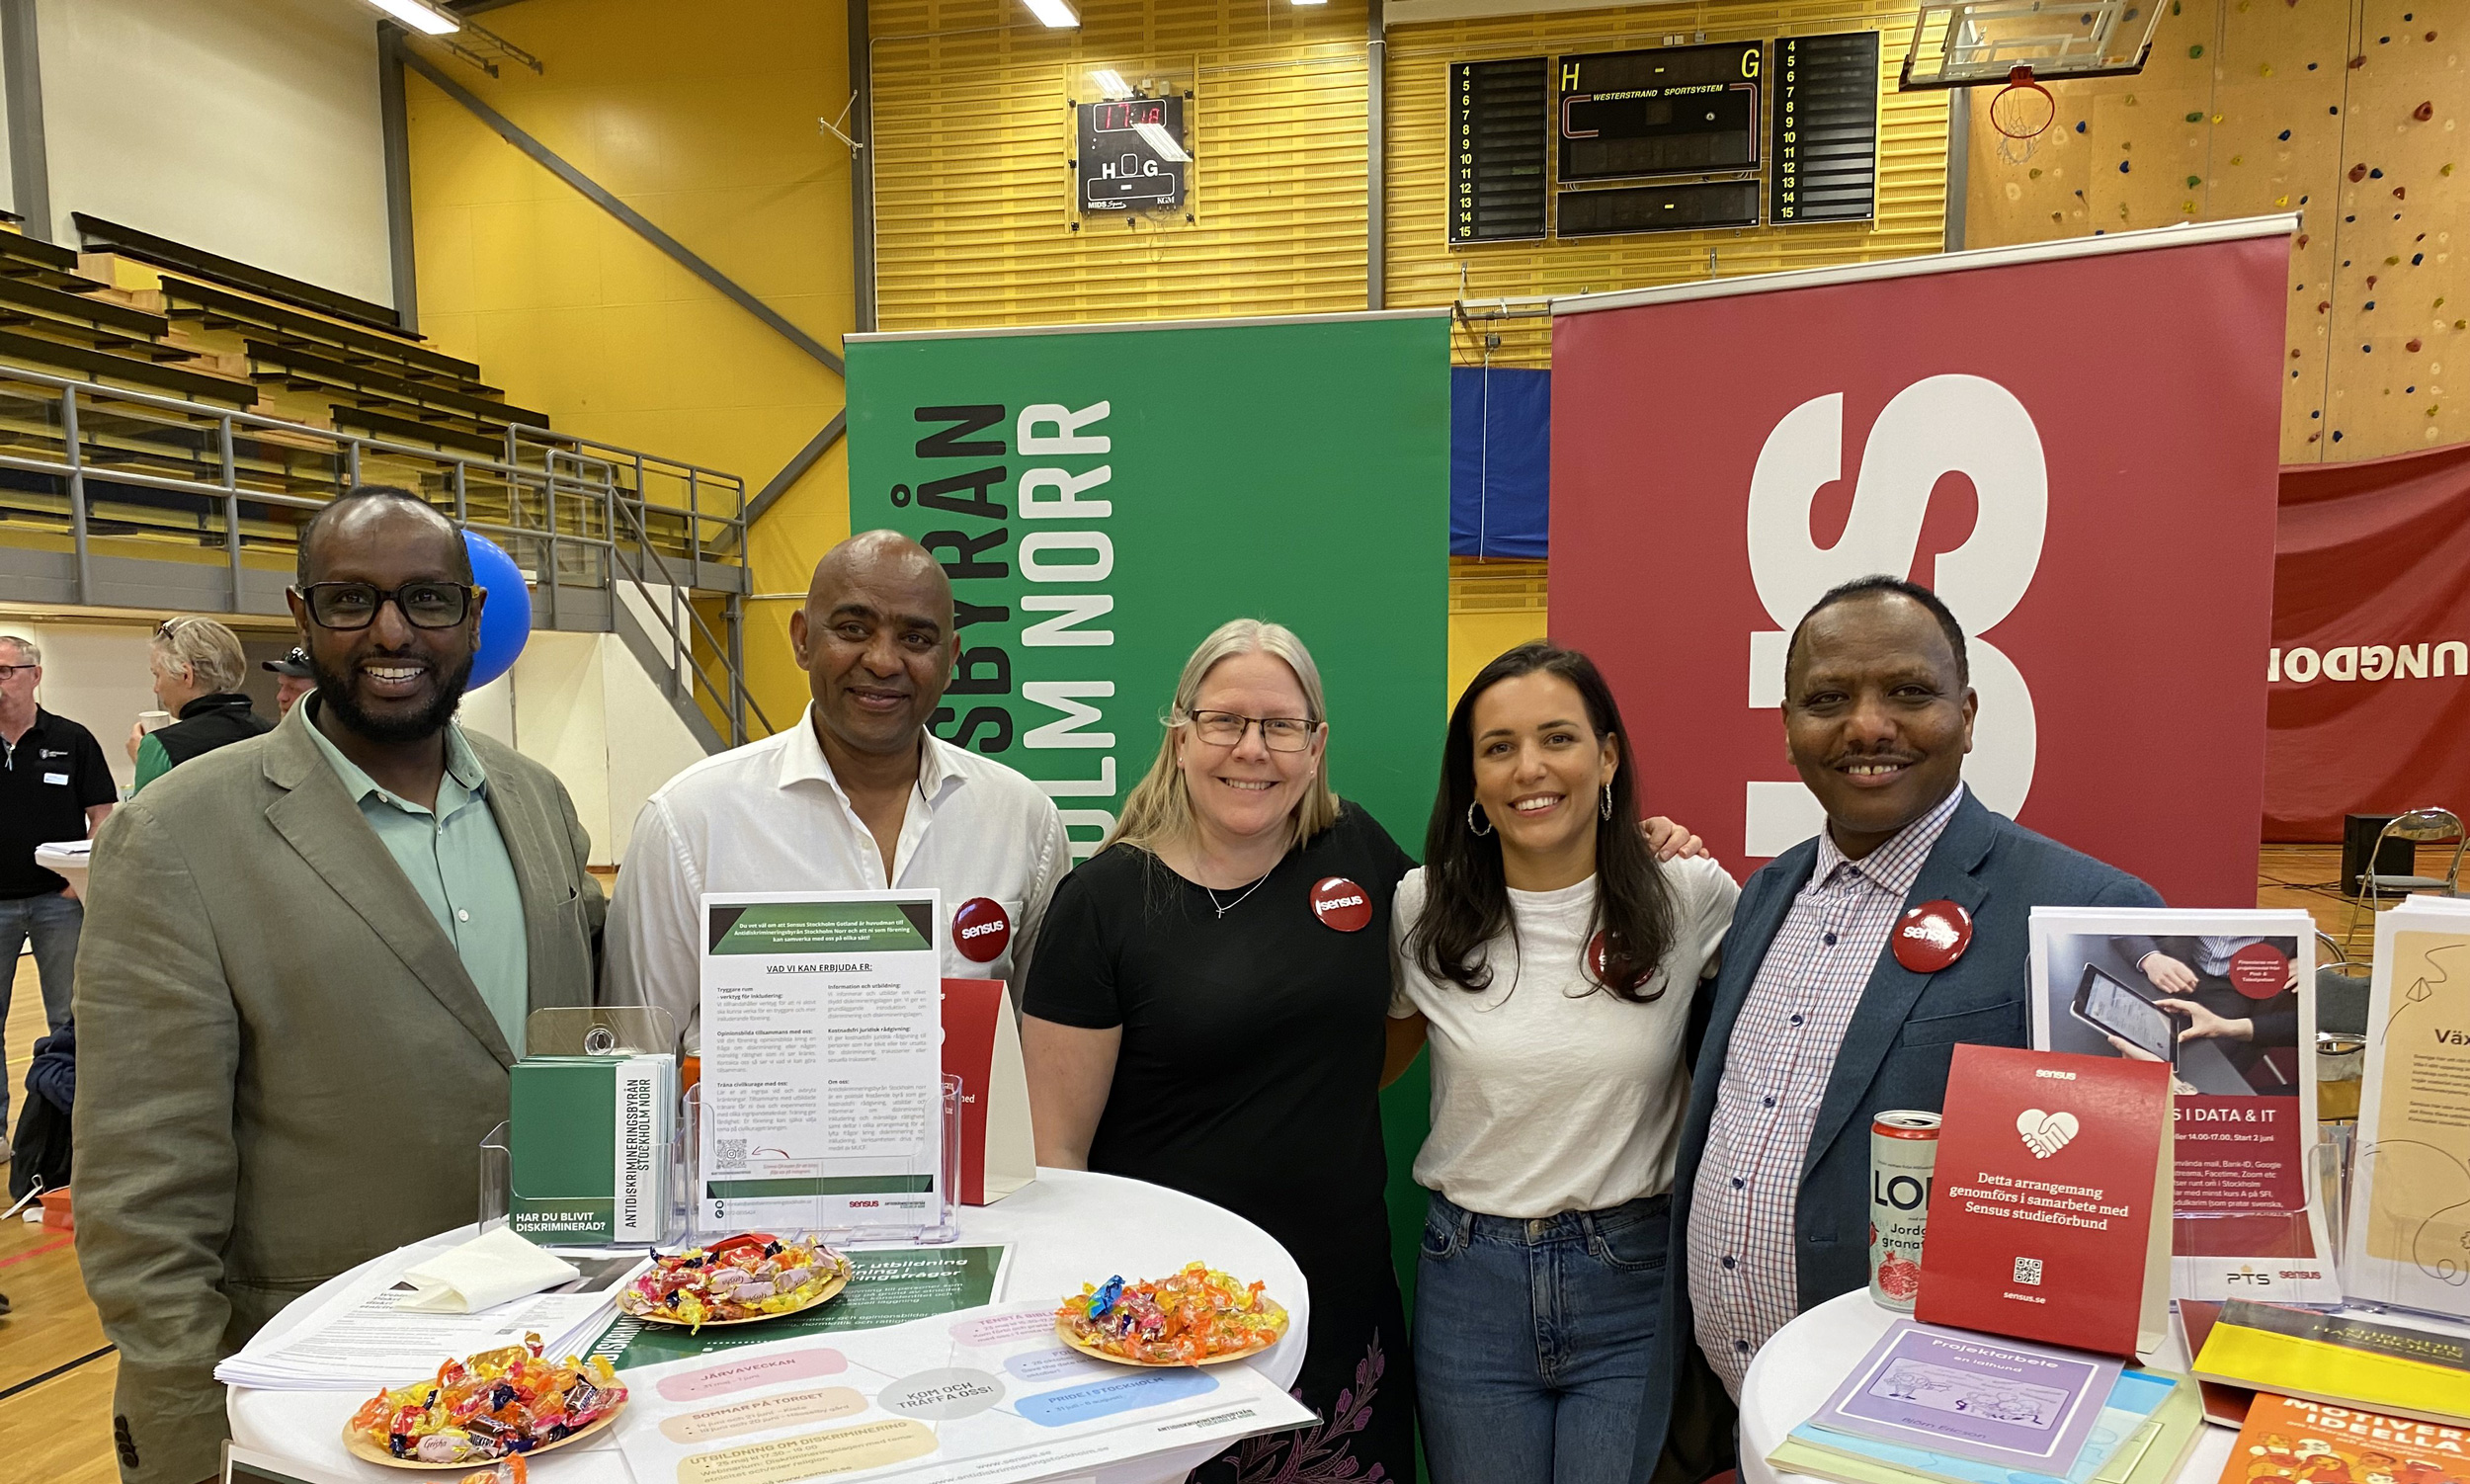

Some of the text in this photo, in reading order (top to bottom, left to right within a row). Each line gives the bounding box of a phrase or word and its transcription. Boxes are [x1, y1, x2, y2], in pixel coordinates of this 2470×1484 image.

[1788, 41, 1795, 51] 4
[1787, 56, 1795, 66] 5
[1463, 66, 1469, 76] 4
[1562, 49, 1759, 91] H G
[1787, 71, 1794, 82] 6
[1463, 81, 1469, 91] 5
[1593, 84, 1723, 101] WESTERSTRAND SPORTSYSTEM
[1787, 87, 1794, 97] 7
[1463, 95, 1469, 105] 6
[1786, 102, 1794, 112] 8
[1463, 110, 1469, 120] 7
[1786, 117, 1793, 128] 9
[1463, 125, 1469, 135] 8
[1783, 132, 1795, 143] 10
[1463, 139, 1469, 149] 9
[1784, 147, 1794, 158] 11
[1460, 154, 1472, 164] 10
[1102, 160, 1158, 179] H G
[1782, 162, 1795, 173] 12
[1461, 168, 1471, 179] 11
[1459, 183, 1472, 193] 12
[1782, 177, 1795, 188] 13
[1460, 198, 1471, 208] 13
[1782, 192, 1794, 203] 14
[1460, 212, 1471, 222] 14
[1781, 207, 1793, 218] 15
[1459, 226, 1471, 236] 15
[1017, 400, 1114, 647] NORR
[2268, 641, 2468, 682] UNGDO
[1320, 896, 1363, 911] sensus
[962, 920, 1004, 939] sensus
[819, 964, 857, 972] ERBJUDA
[2036, 1069, 2076, 1080] sensus
[2186, 1109, 2190, 1121] I
[2195, 1109, 2241, 1121] DATA
[2245, 1110, 2256, 1122] &
[2262, 1110, 2276, 1122] IT
[637, 1079, 650, 1171] STOCKHOLM NORR
[624, 1079, 638, 1228] ANTIDISKRIMINERINGSBYRÅN
[1978, 1172, 2103, 1201] Detta arrangemang
[849, 1200, 879, 1209] sensus
[1949, 1186, 2129, 1217] genomförs i samarbete med
[516, 1212, 594, 1222] HAR DU BLIVIT
[1965, 1201, 2107, 1231] Sensus studieförbund
[516, 1222, 606, 1232] DISKRIMINERAD?
[870, 1258, 968, 1268] utbildning
[2227, 1271, 2321, 1285] PTS sensus
[2004, 1291, 2046, 1305] sensus.se
[1932, 1339, 2058, 1369] Projektarbete
[701, 1359, 796, 1381] JÄRVAVECKAN
[1973, 1359, 2022, 1373] lathund
[897, 1385, 994, 1409] TRÄFFA OSS!
[906, 1382, 973, 1401] KOM OCH
[2283, 1399, 2470, 1443] MOTIVER
[2306, 1414, 2462, 1453] IDEELLA
[423, 1437, 447, 1450] Geisha
[690, 1444, 775, 1465] UTBILDNING
[777, 1441, 797, 1450] OM
